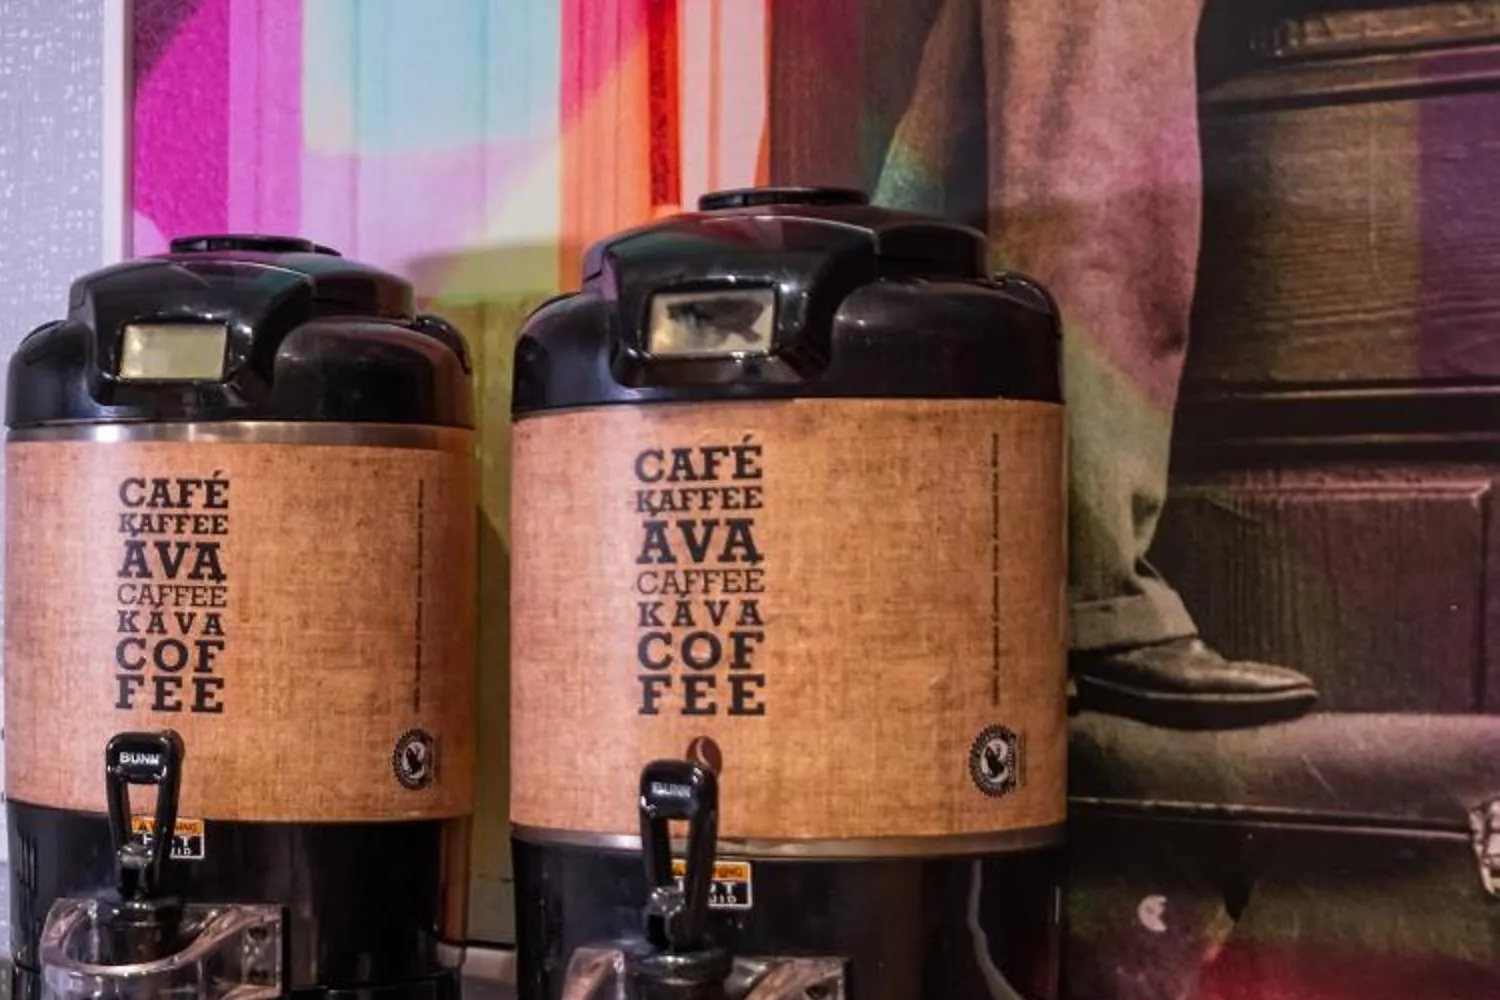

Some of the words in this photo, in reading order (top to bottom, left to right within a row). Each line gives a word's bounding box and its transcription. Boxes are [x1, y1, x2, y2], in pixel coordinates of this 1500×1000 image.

[634, 434, 763, 483] CAFÉ
[119, 469, 230, 509] CAFÉ
[634, 486, 763, 513] KAFFEE
[118, 512, 229, 535] KAFFEE
[115, 637, 226, 673] COF
[637, 630, 765, 671] COF
[115, 674, 225, 713] FEE
[638, 674, 765, 716] FEE
[119, 752, 160, 765] BUNN
